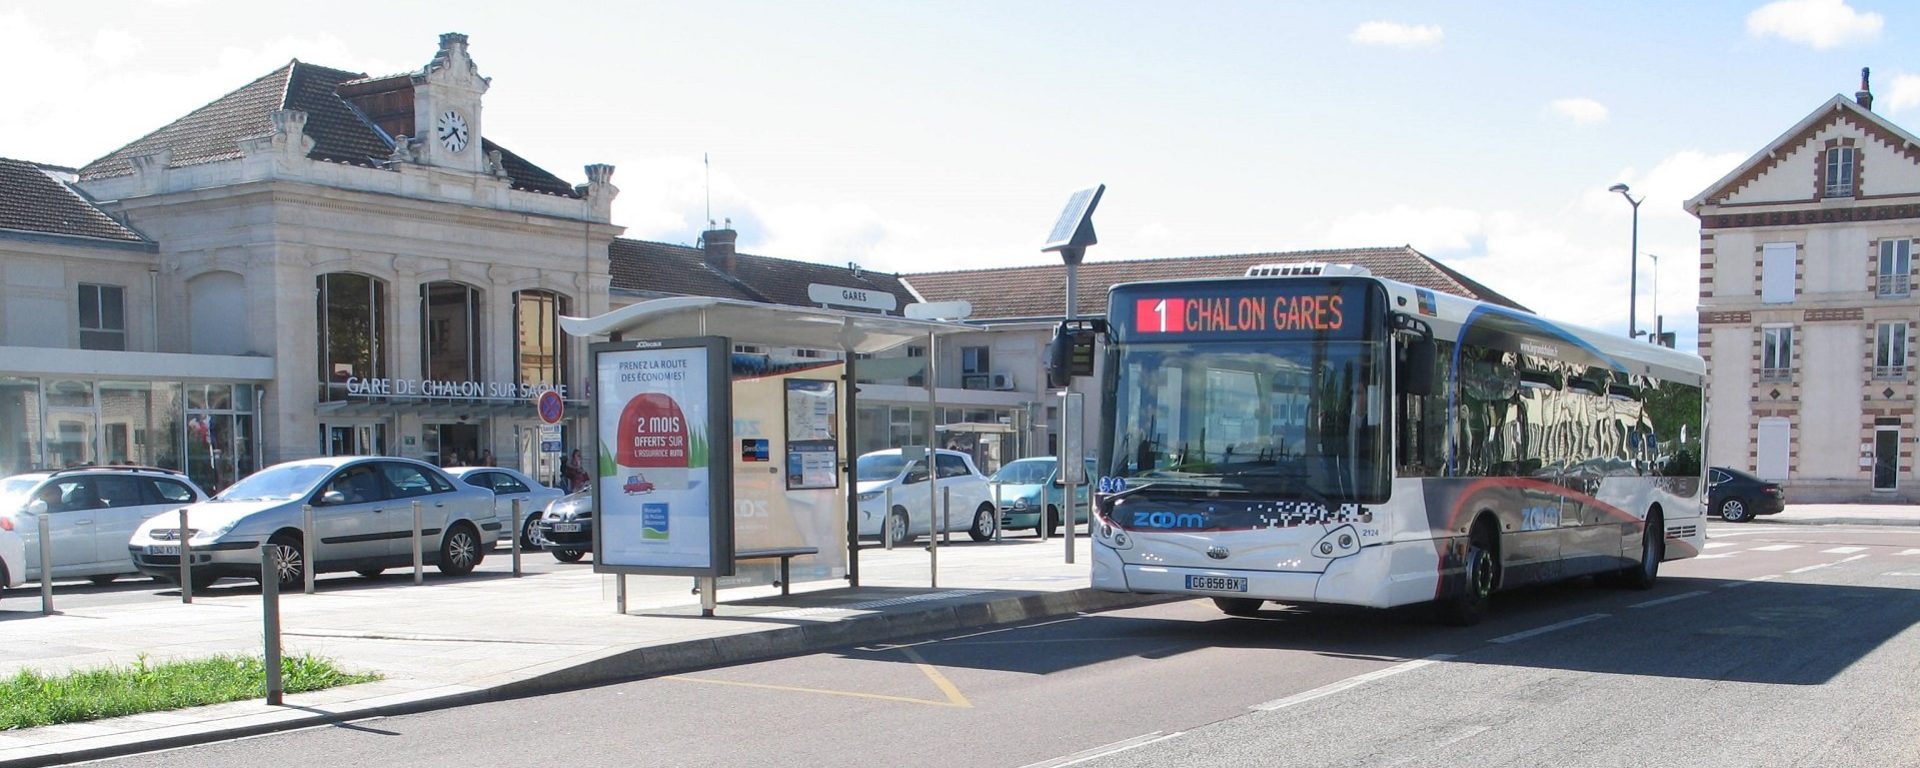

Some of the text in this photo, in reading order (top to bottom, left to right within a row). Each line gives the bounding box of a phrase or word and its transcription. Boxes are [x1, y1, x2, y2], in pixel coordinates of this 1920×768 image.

[842, 290, 867, 302] GARES
[1154, 295, 1344, 332] 1 CHALON GARES
[619, 359, 688, 370] PRENEZ LA ROUTE
[621, 373, 636, 382] DES
[346, 376, 391, 394] GARE
[396, 379, 417, 395] DE
[422, 379, 485, 397] CHALON
[490, 382, 518, 398] SUR
[638, 416, 680, 433] 2 MOIS
[669, 435, 683, 447] SUR
[670, 449, 684, 458] AUTO
[1134, 511, 1204, 529] zoom
[1362, 529, 1379, 537] 2124
